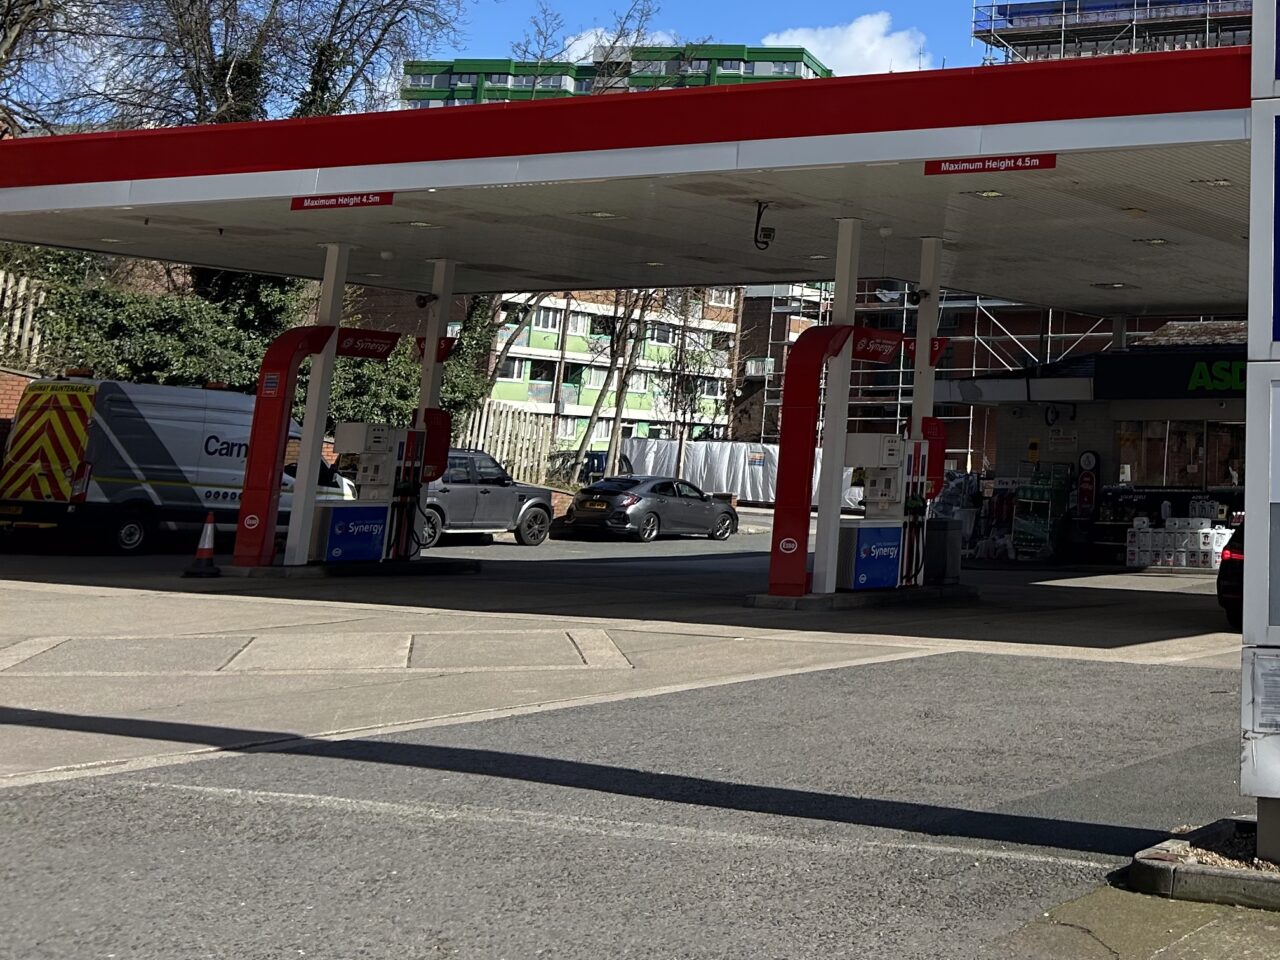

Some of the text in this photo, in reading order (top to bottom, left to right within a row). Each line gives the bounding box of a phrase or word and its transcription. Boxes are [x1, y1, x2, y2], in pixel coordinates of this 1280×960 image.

[941, 157, 1039, 171] Maximum Height 4.5m
[303, 194, 380, 207] Maximum Height 4.5m
[354, 339, 390, 352] Synergy
[867, 340, 895, 355] Synergy
[908, 342, 915, 350] 4
[933, 341, 939, 350] 3
[348, 521, 384, 535] Synergy
[871, 544, 899, 559] Synergy
